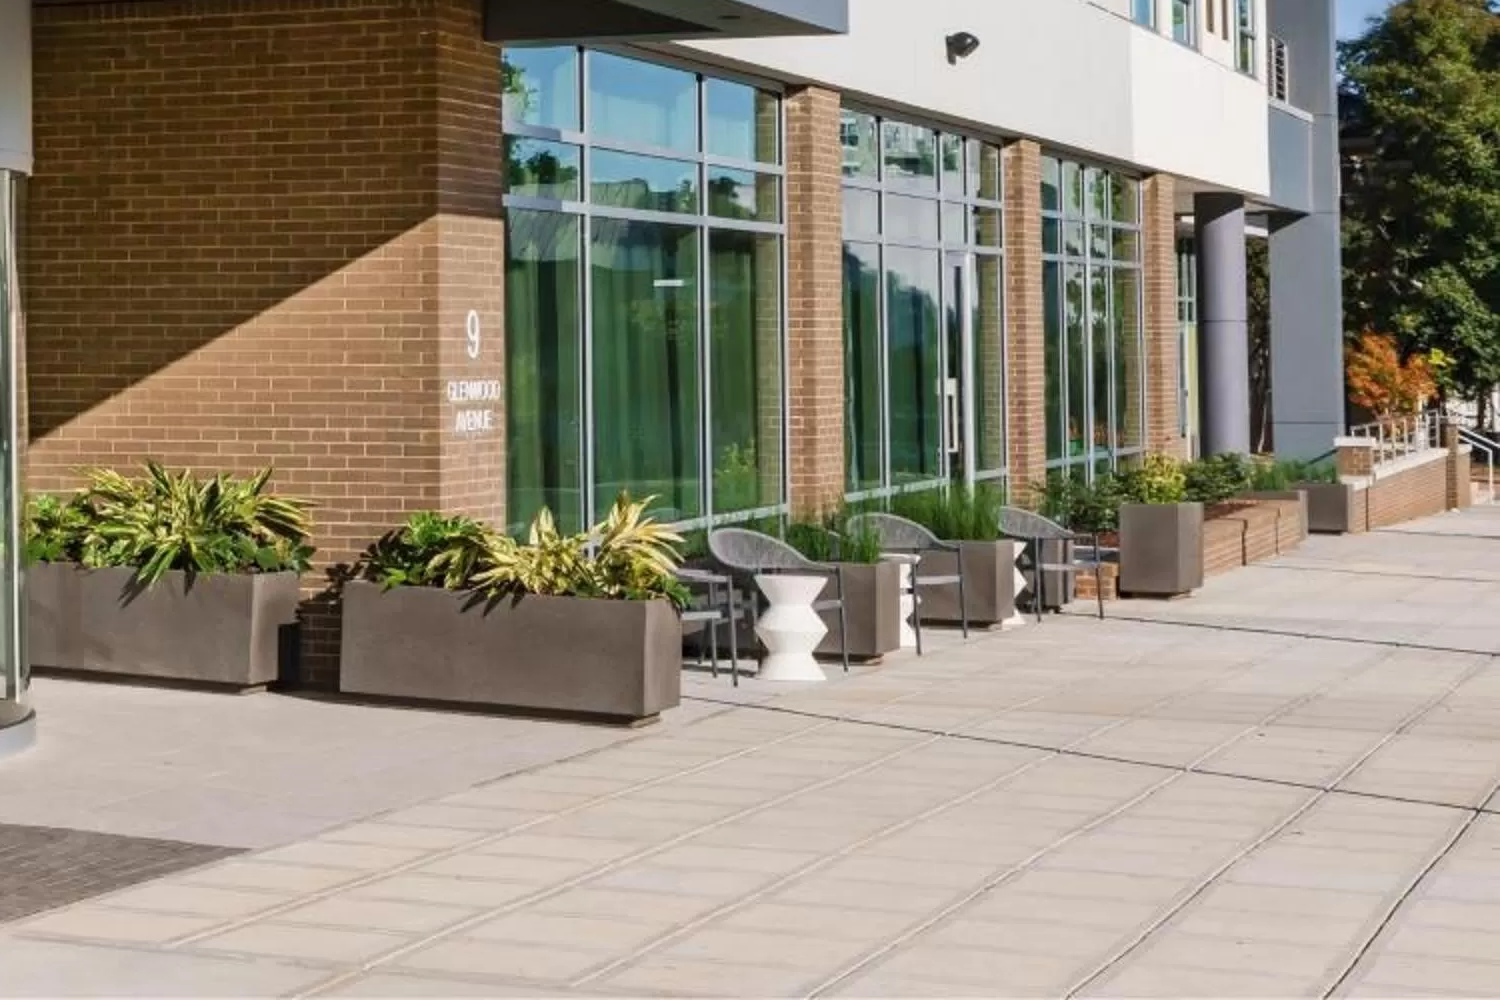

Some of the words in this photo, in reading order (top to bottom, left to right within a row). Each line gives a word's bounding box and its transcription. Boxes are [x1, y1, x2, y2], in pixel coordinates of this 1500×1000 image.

[467, 309, 480, 358] 9
[448, 380, 501, 401] GLENWOOD
[455, 410, 493, 432] AVENUE
